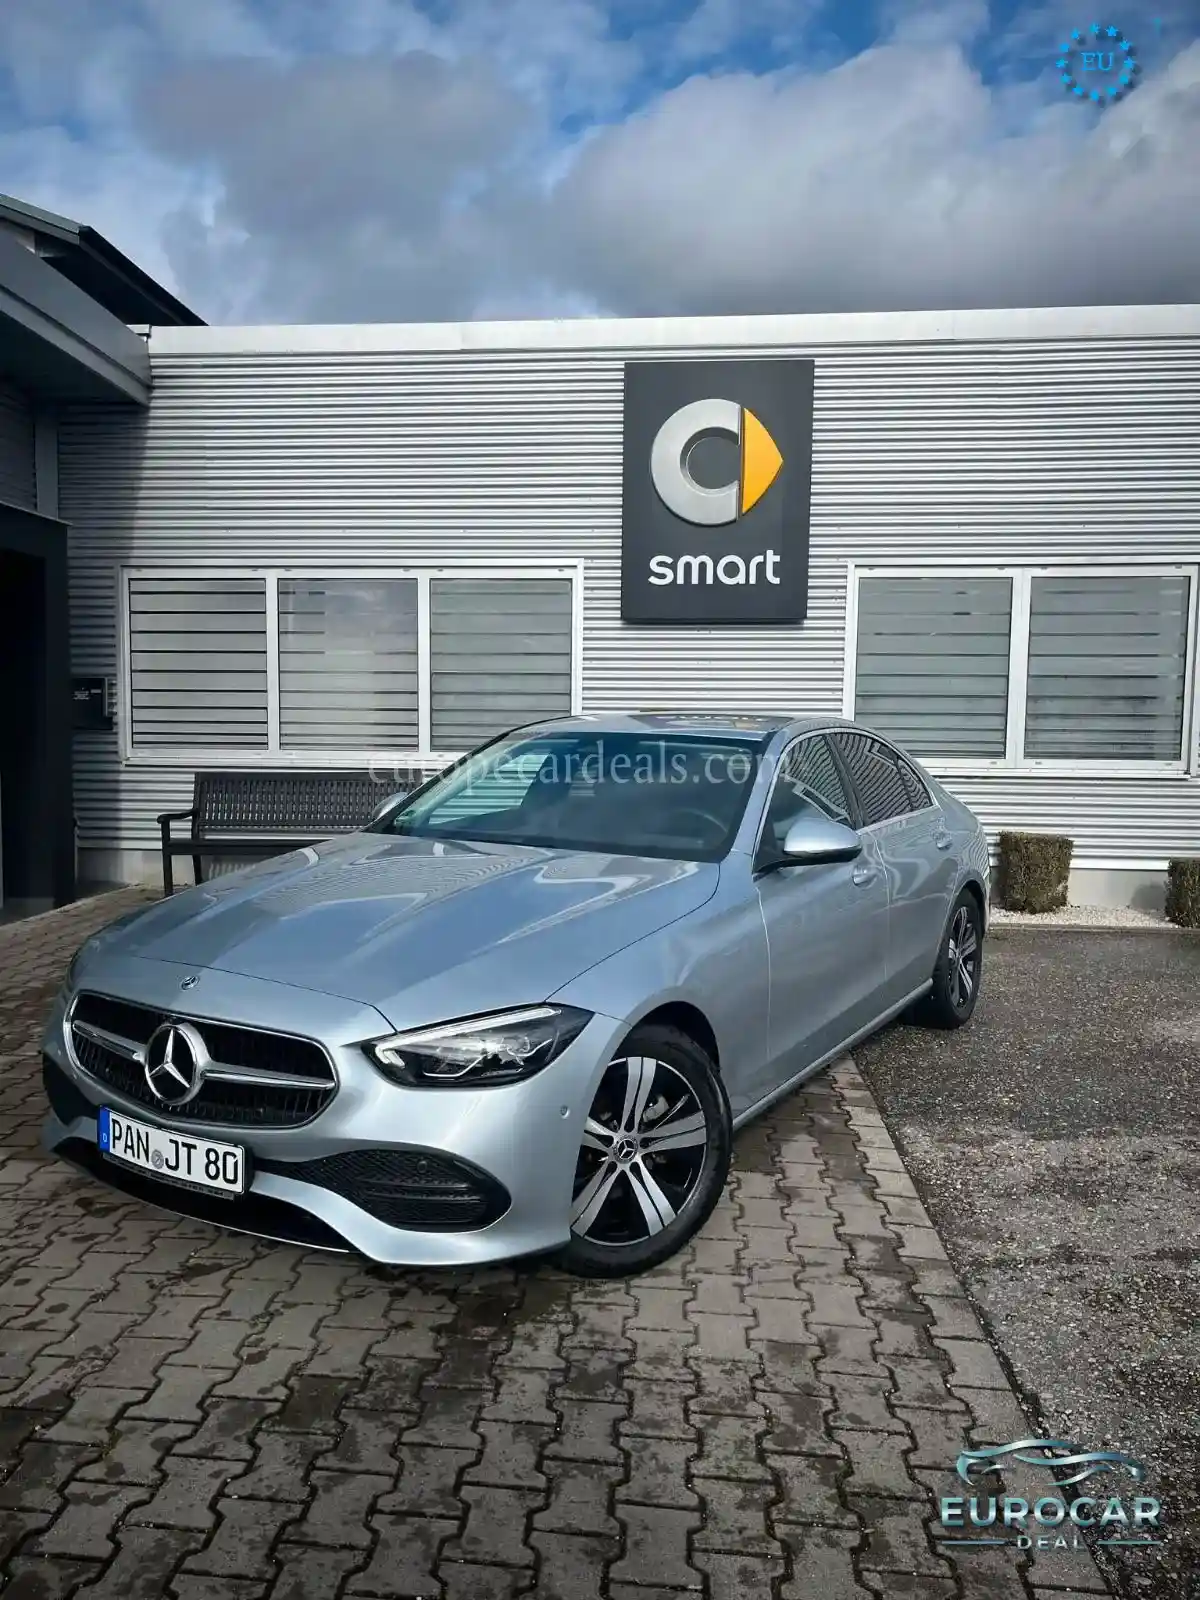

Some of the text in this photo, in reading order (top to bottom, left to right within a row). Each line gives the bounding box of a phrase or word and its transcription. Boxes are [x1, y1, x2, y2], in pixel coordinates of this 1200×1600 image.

[648, 549, 781, 585] smart
[102, 1133, 108, 1142] D
[111, 1118, 149, 1163] PAN
[165, 1138, 197, 1175] JT
[205, 1148, 238, 1185] 80
